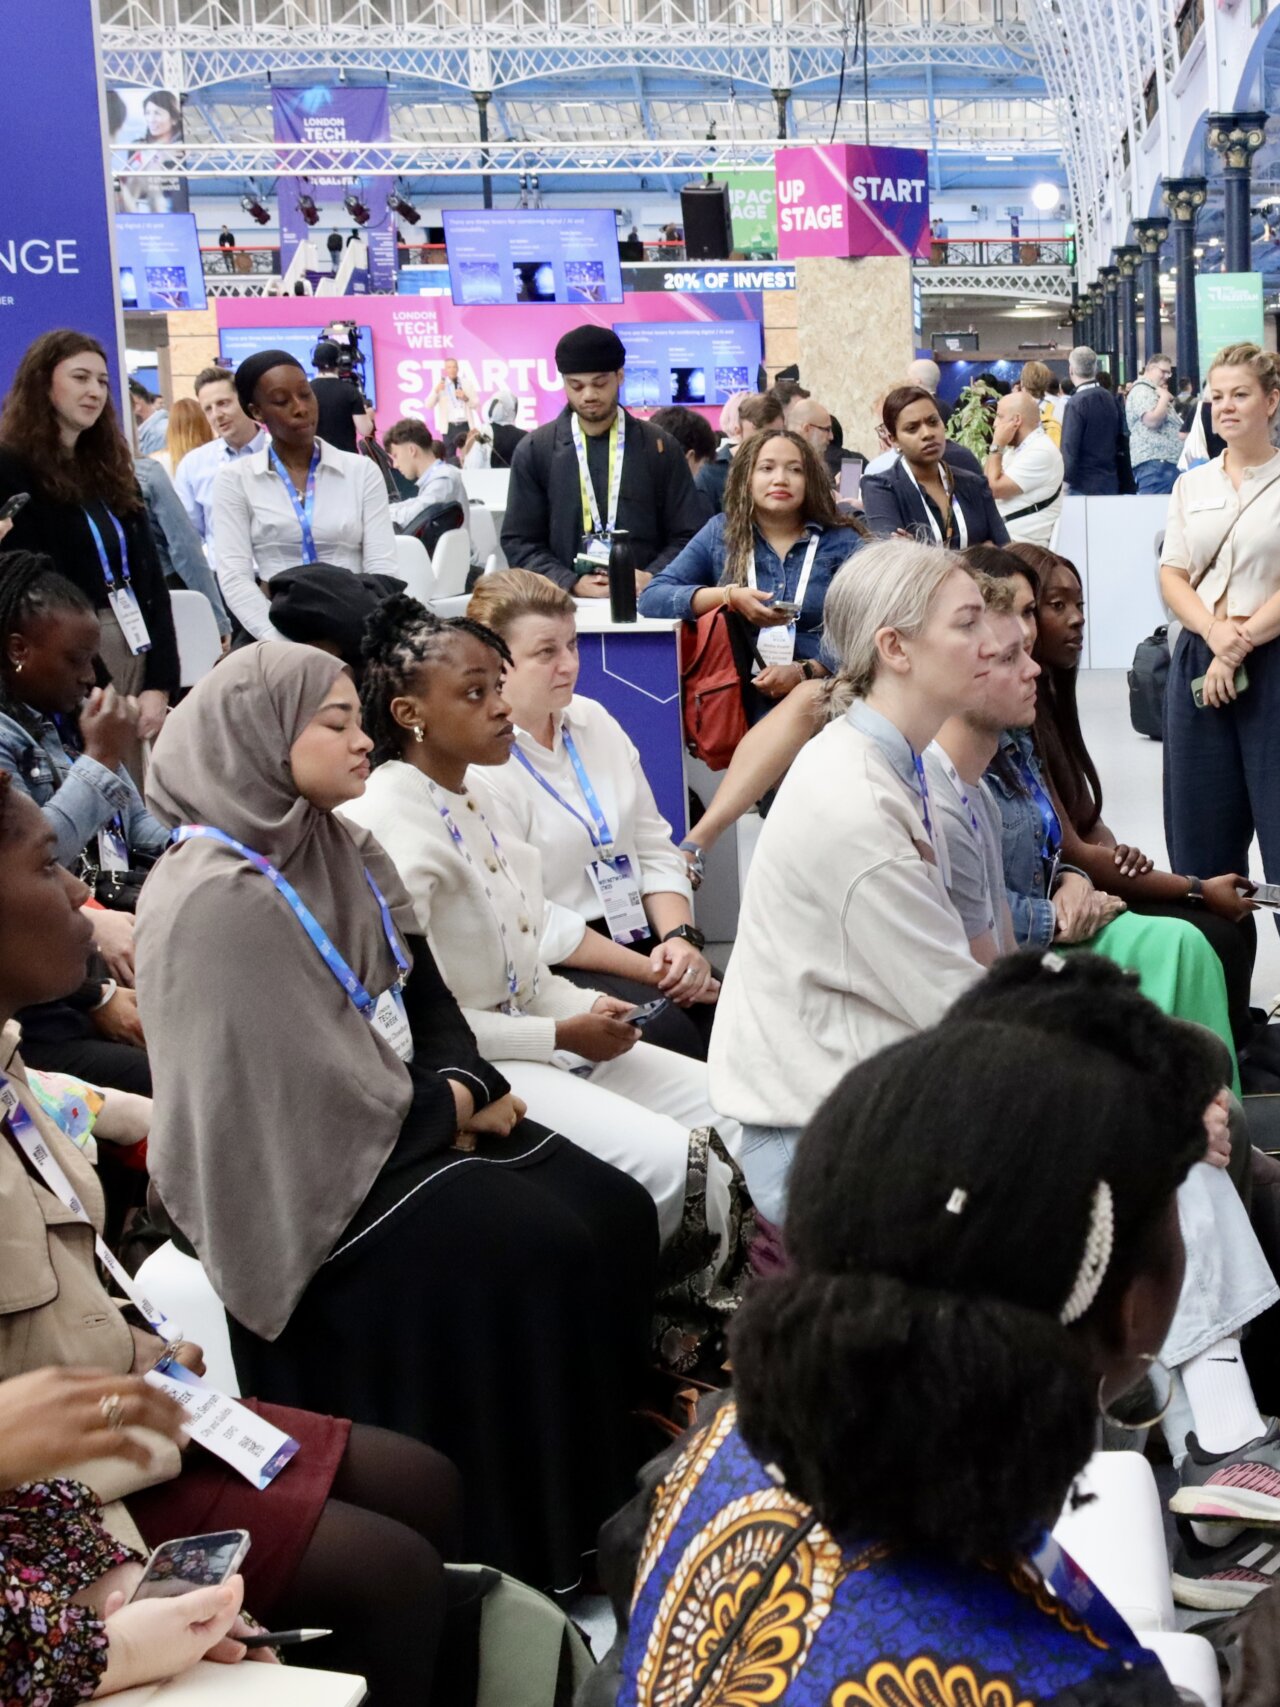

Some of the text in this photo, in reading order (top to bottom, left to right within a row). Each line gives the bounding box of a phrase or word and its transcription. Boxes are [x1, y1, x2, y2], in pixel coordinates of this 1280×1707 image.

[303, 117, 345, 127] LONDON
[304, 127, 347, 140] TECH
[778, 179, 805, 205] UP
[852, 176, 925, 203] START
[780, 204, 843, 232] STAGE
[664, 272, 700, 290] 20%
[705, 272, 729, 289] OF
[393, 311, 436, 320] LONDON
[393, 321, 438, 335] TECH
[406, 335, 454, 349] WEEK
